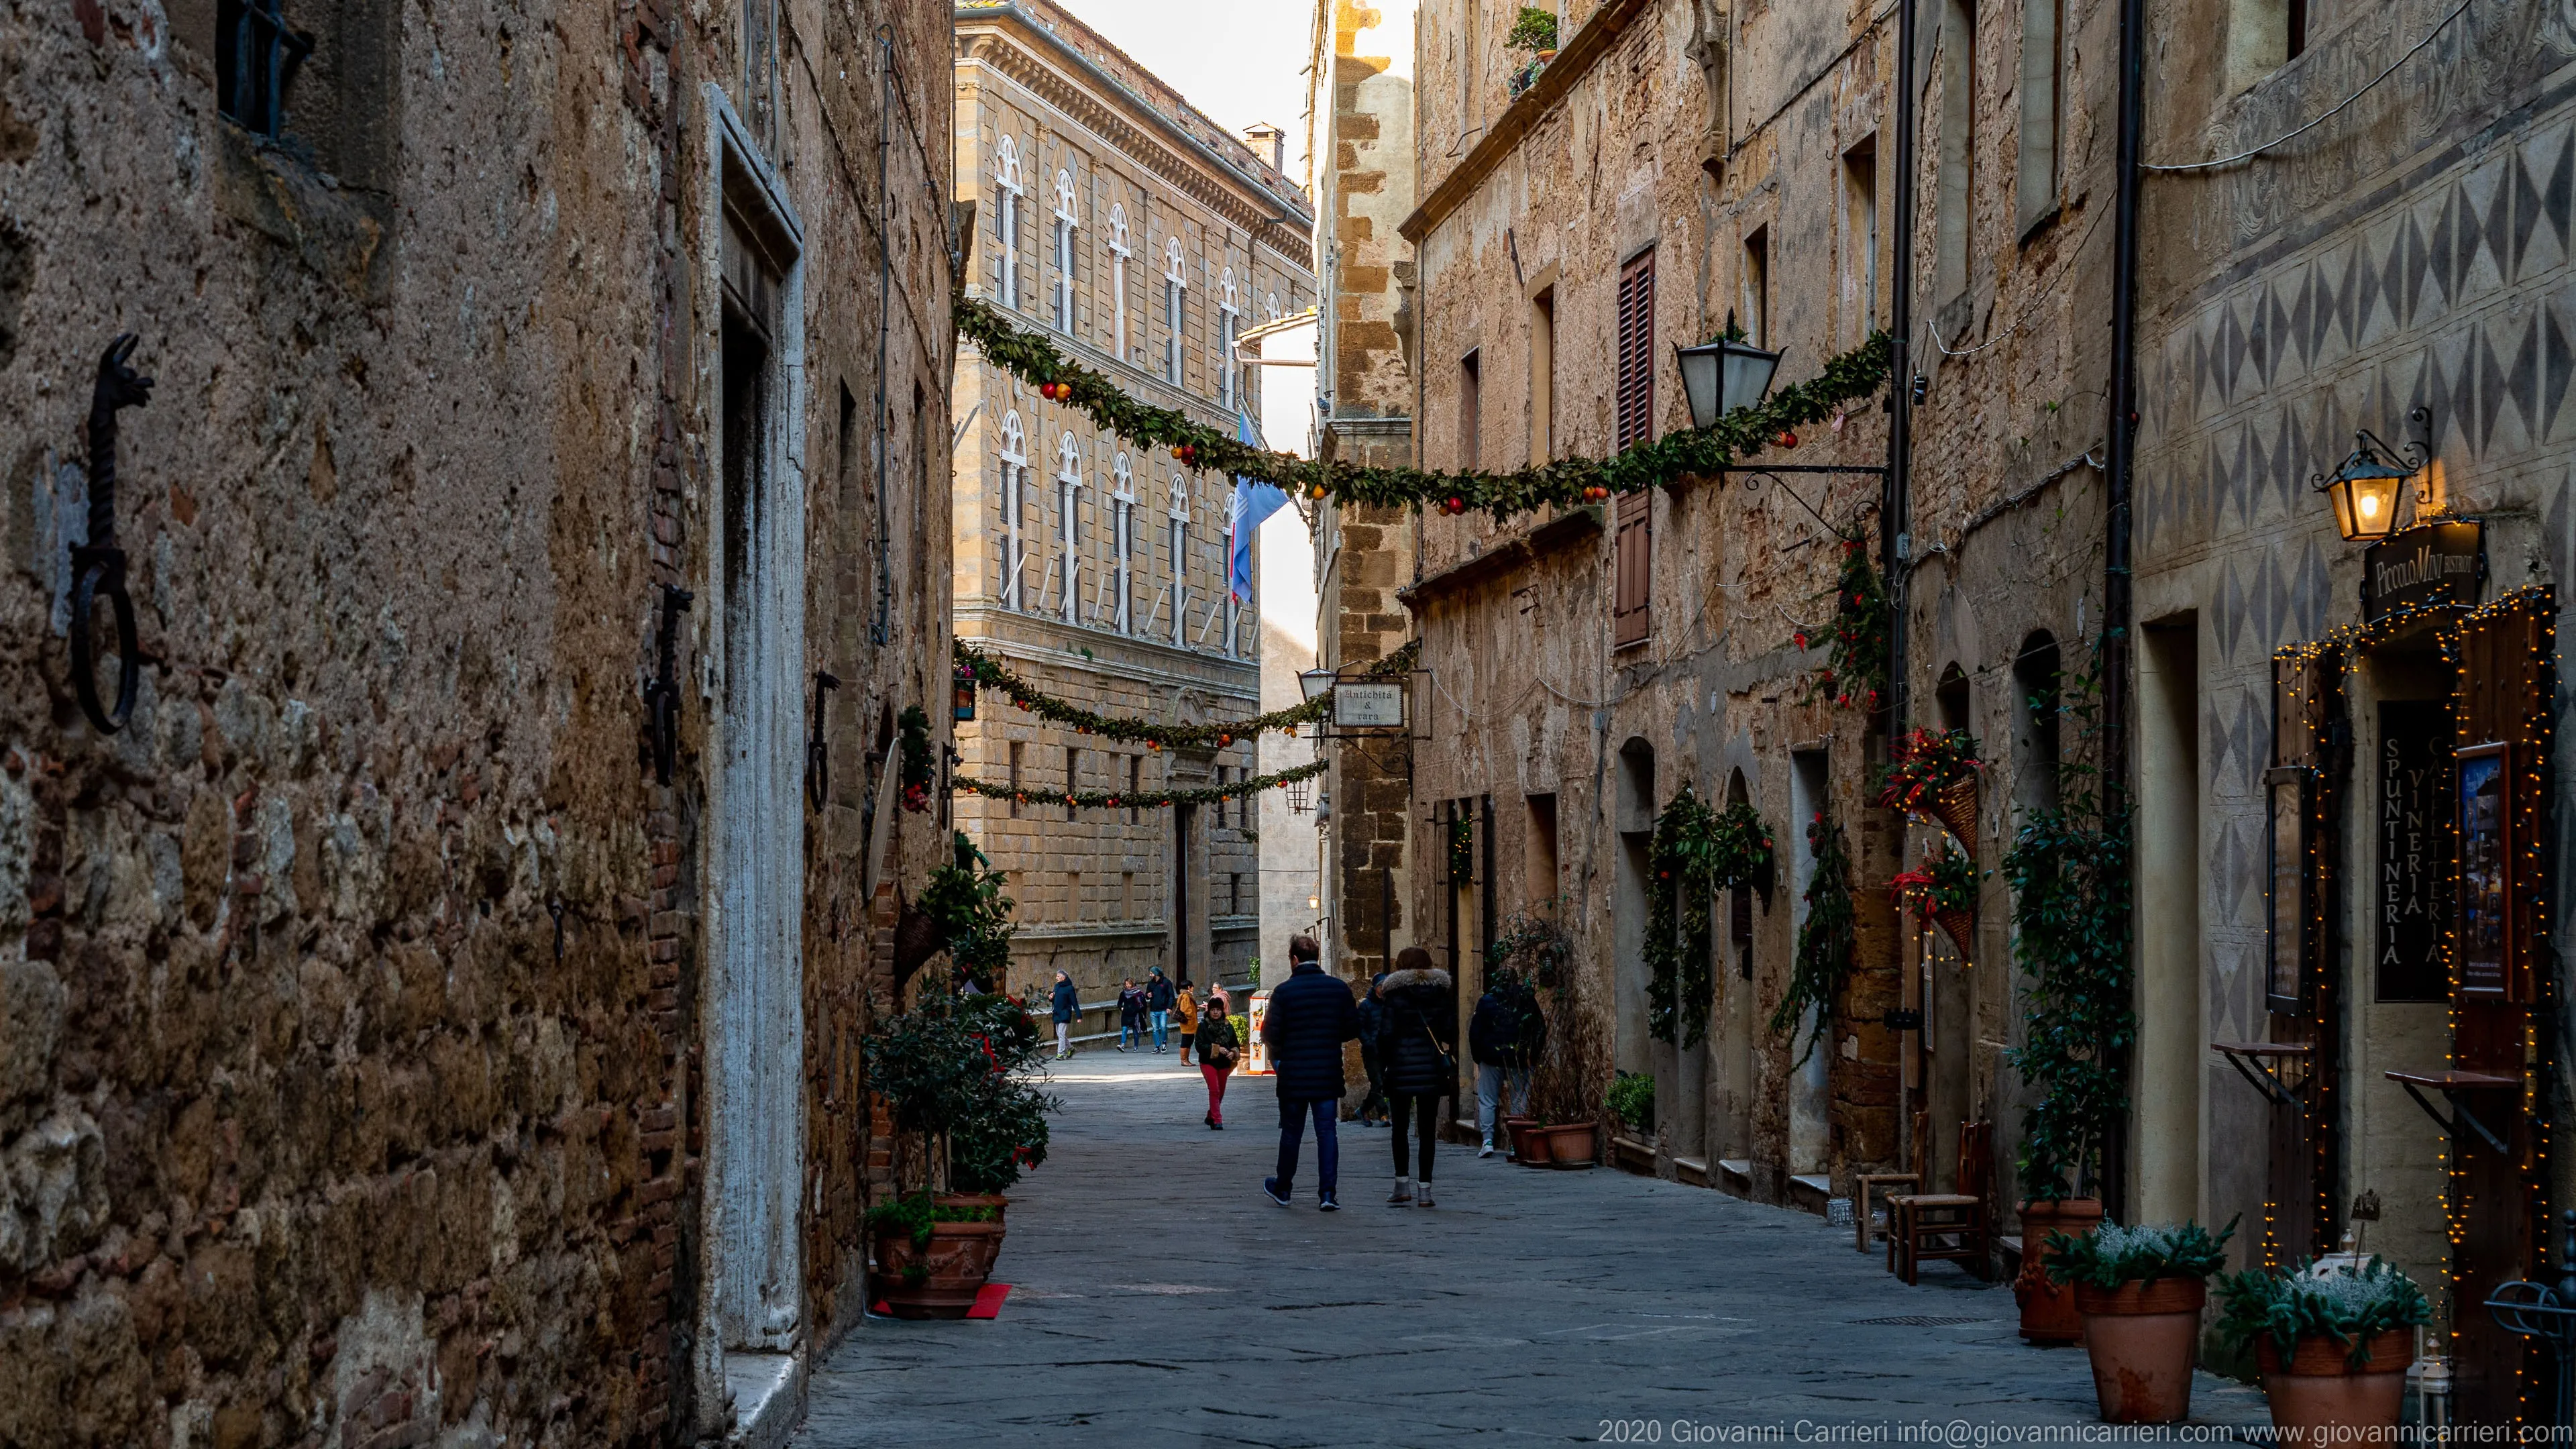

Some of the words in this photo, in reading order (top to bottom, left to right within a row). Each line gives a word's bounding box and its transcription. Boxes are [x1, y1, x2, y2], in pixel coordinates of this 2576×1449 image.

[2383, 738, 2402, 965] SPUNTINERIA
[2404, 768, 2424, 914] VINERIA
[2426, 736, 2443, 963] CAFFETTERIA
